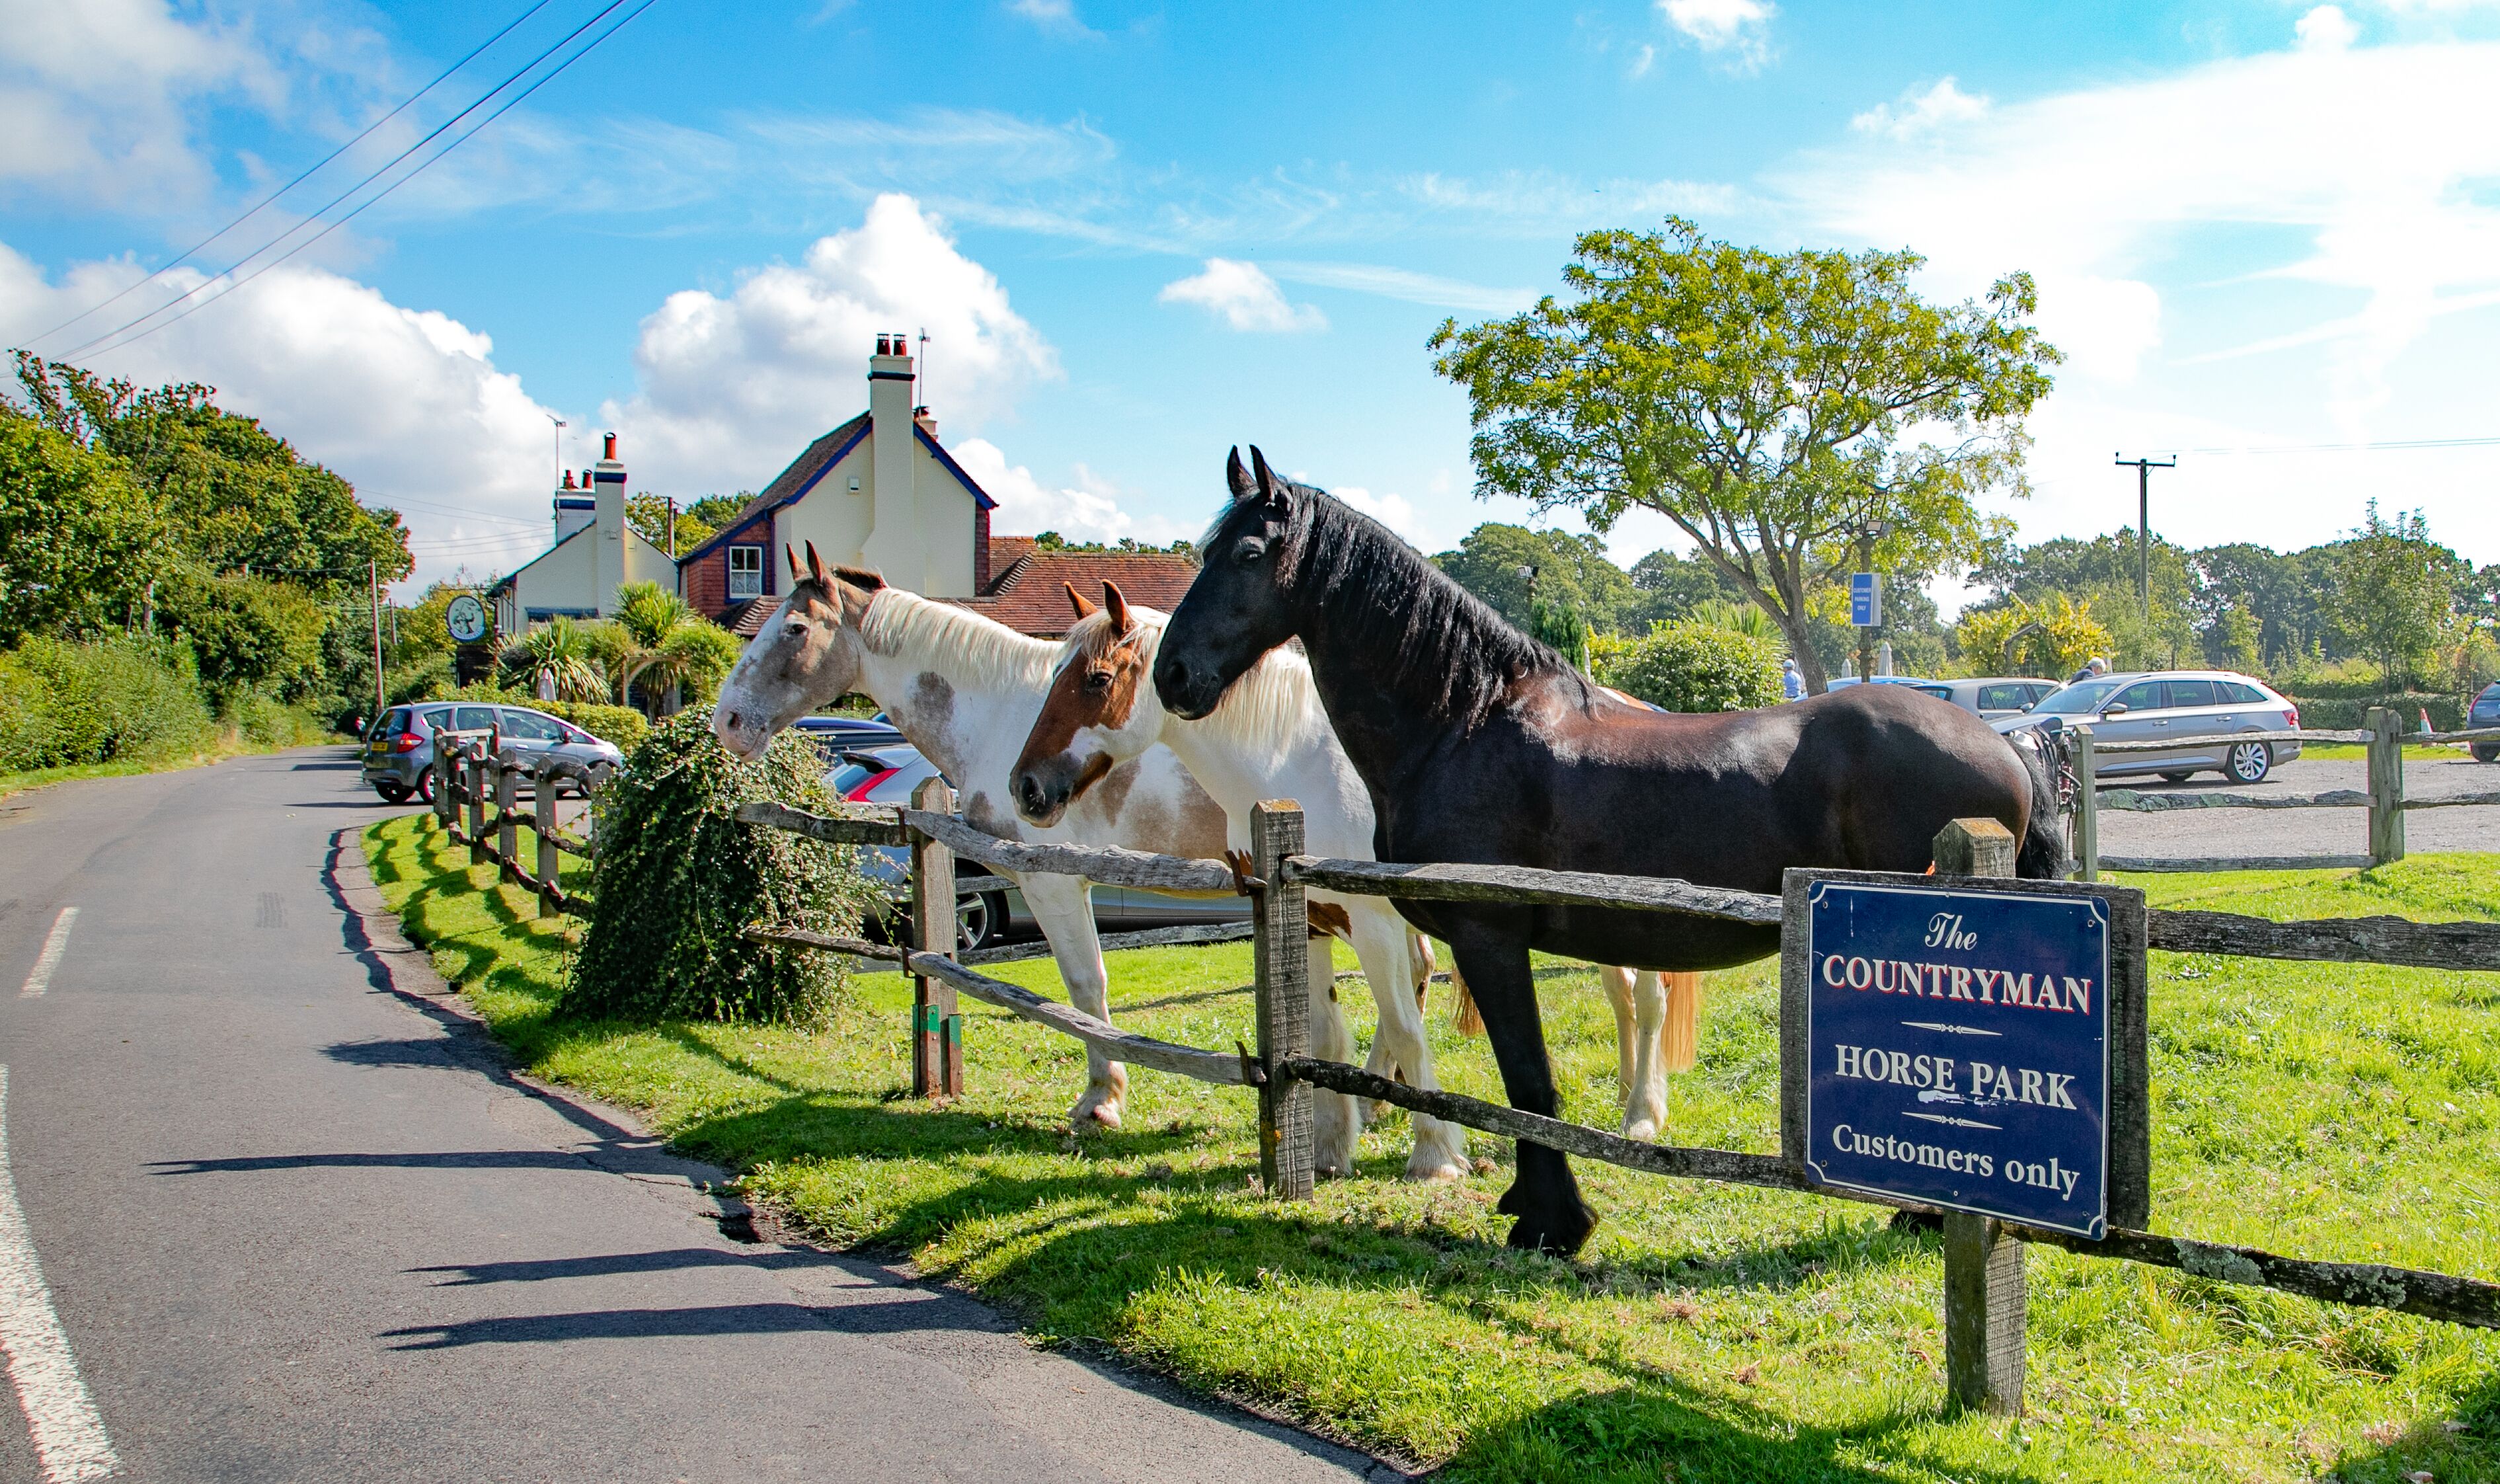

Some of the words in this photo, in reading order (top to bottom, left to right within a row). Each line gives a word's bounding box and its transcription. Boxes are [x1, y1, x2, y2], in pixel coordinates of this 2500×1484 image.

[1925, 913, 1976, 950] The
[1823, 955, 2092, 1015] COUNTRYMAN
[1836, 1044, 1955, 1091] HORSE
[1970, 1062, 2076, 1109] PARK
[1833, 1124, 1994, 1177] Customers
[2006, 1158, 2080, 1200] only
